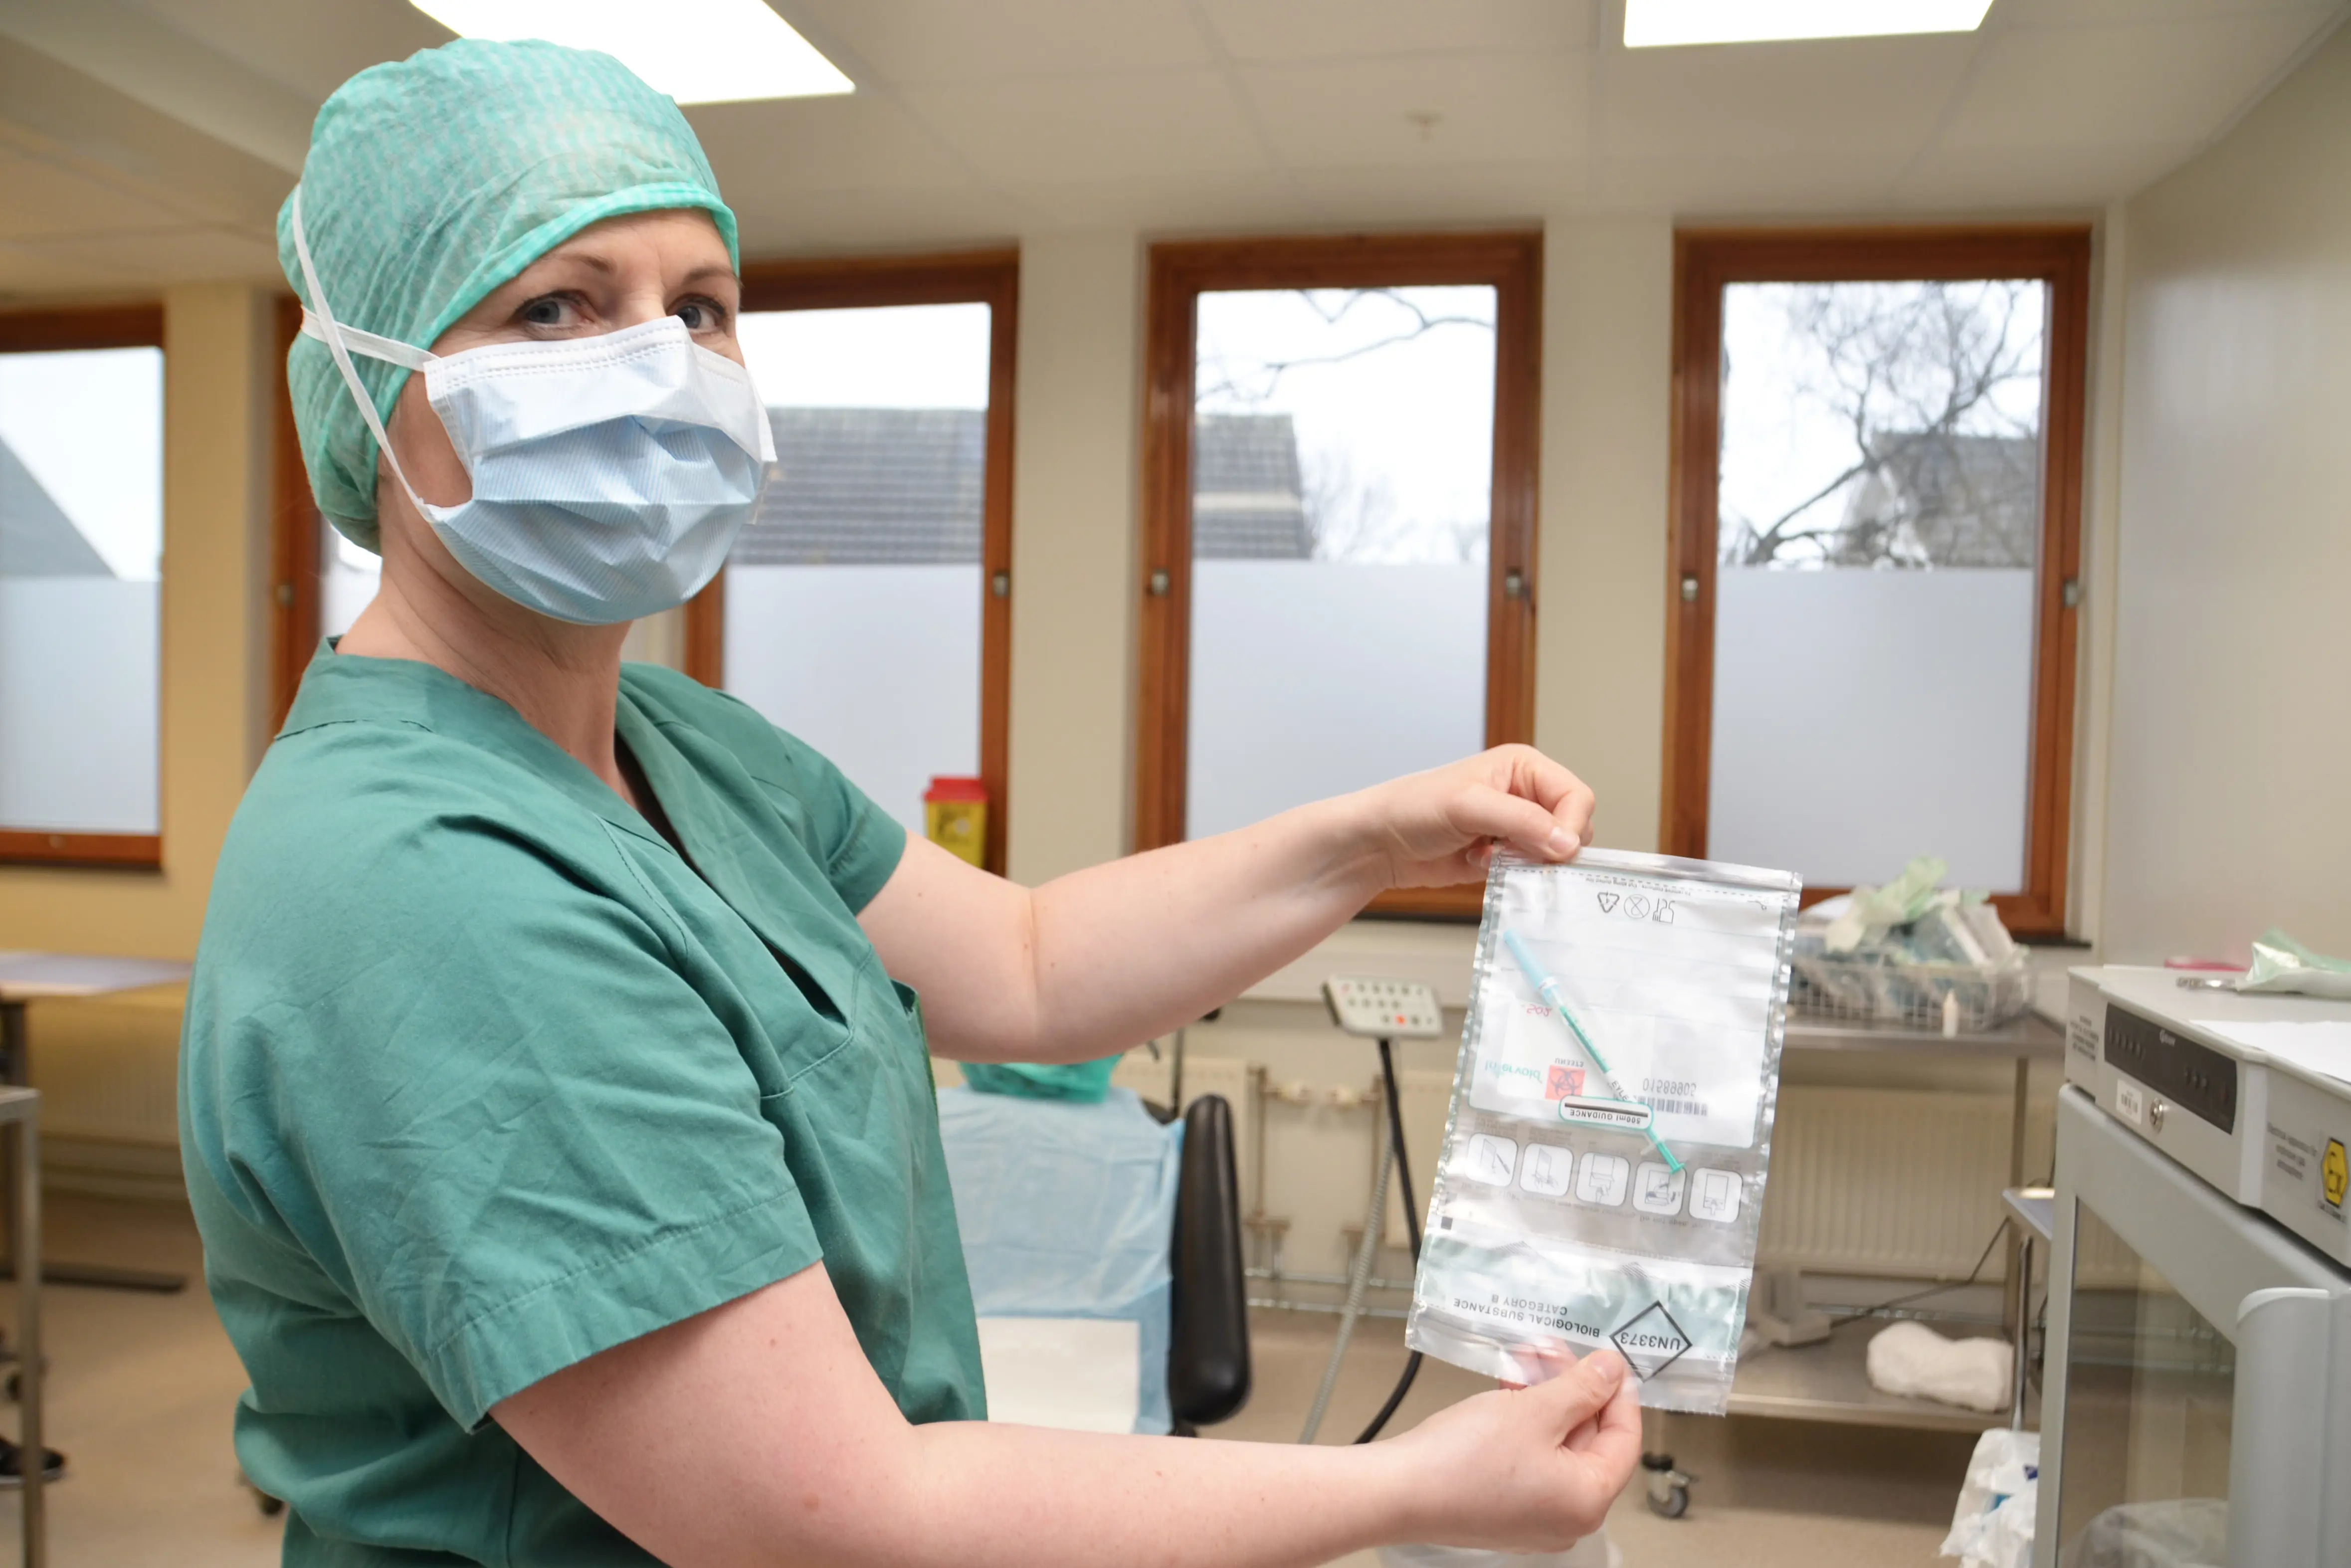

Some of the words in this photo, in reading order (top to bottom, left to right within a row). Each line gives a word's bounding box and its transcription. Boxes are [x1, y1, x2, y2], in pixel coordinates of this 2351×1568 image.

[1611, 1080, 1629, 1101] EYLE
[1570, 1109, 1613, 1121] GUIDANCE
[1616, 1115, 1641, 1124] 500ml
[1491, 1294, 1500, 1304] B
[1502, 1297, 1567, 1316] CATEGORY
[1453, 1298, 1525, 1322] SUBSTANCE
[1530, 1313, 1600, 1338] BIOLOGICAL
[1620, 1332, 1680, 1351] UN3373
